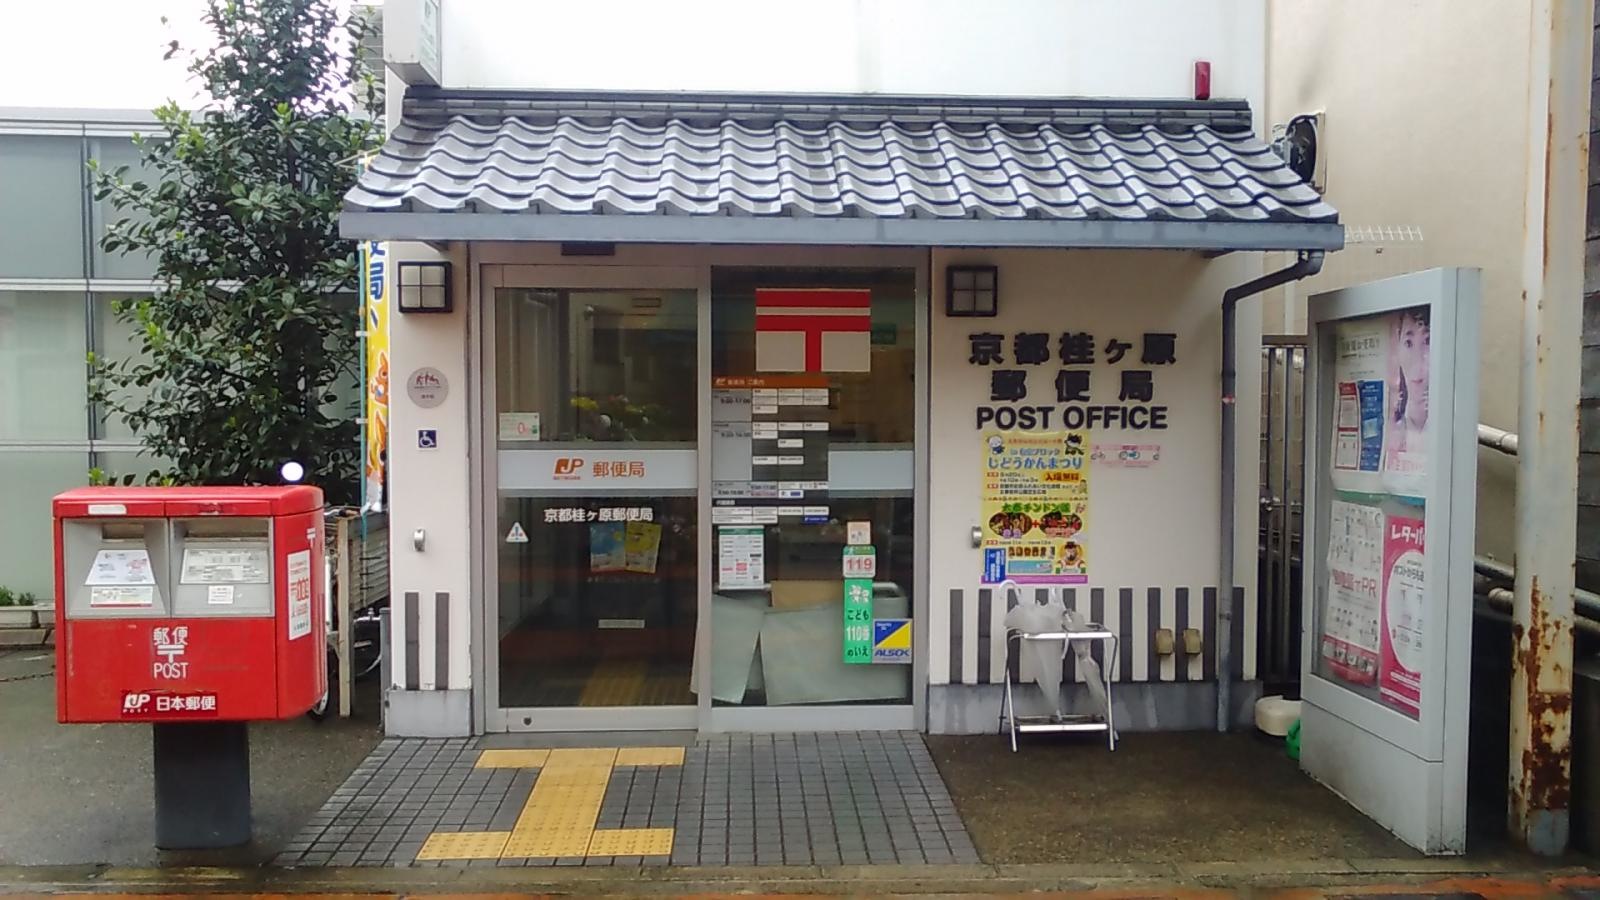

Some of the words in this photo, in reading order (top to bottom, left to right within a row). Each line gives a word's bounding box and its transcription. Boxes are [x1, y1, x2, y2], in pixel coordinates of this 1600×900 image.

[990, 369, 1153, 402] 郵便局
[976, 406, 1055, 430] POST
[1062, 405, 1168, 430] OFFICE
[554, 458, 584, 475] JP
[592, 462, 645, 477] 郵便局
[988, 457, 1082, 469] じどうかんまつり
[847, 558, 873, 570] 119
[847, 610, 869, 620] こども
[153, 626, 188, 646] 郵便
[847, 646, 869, 656] のいえ
[874, 649, 910, 657] ALSOK
[153, 662, 189, 679] POST
[124, 693, 151, 708] JP
[156, 696, 216, 711] 日本郵便
